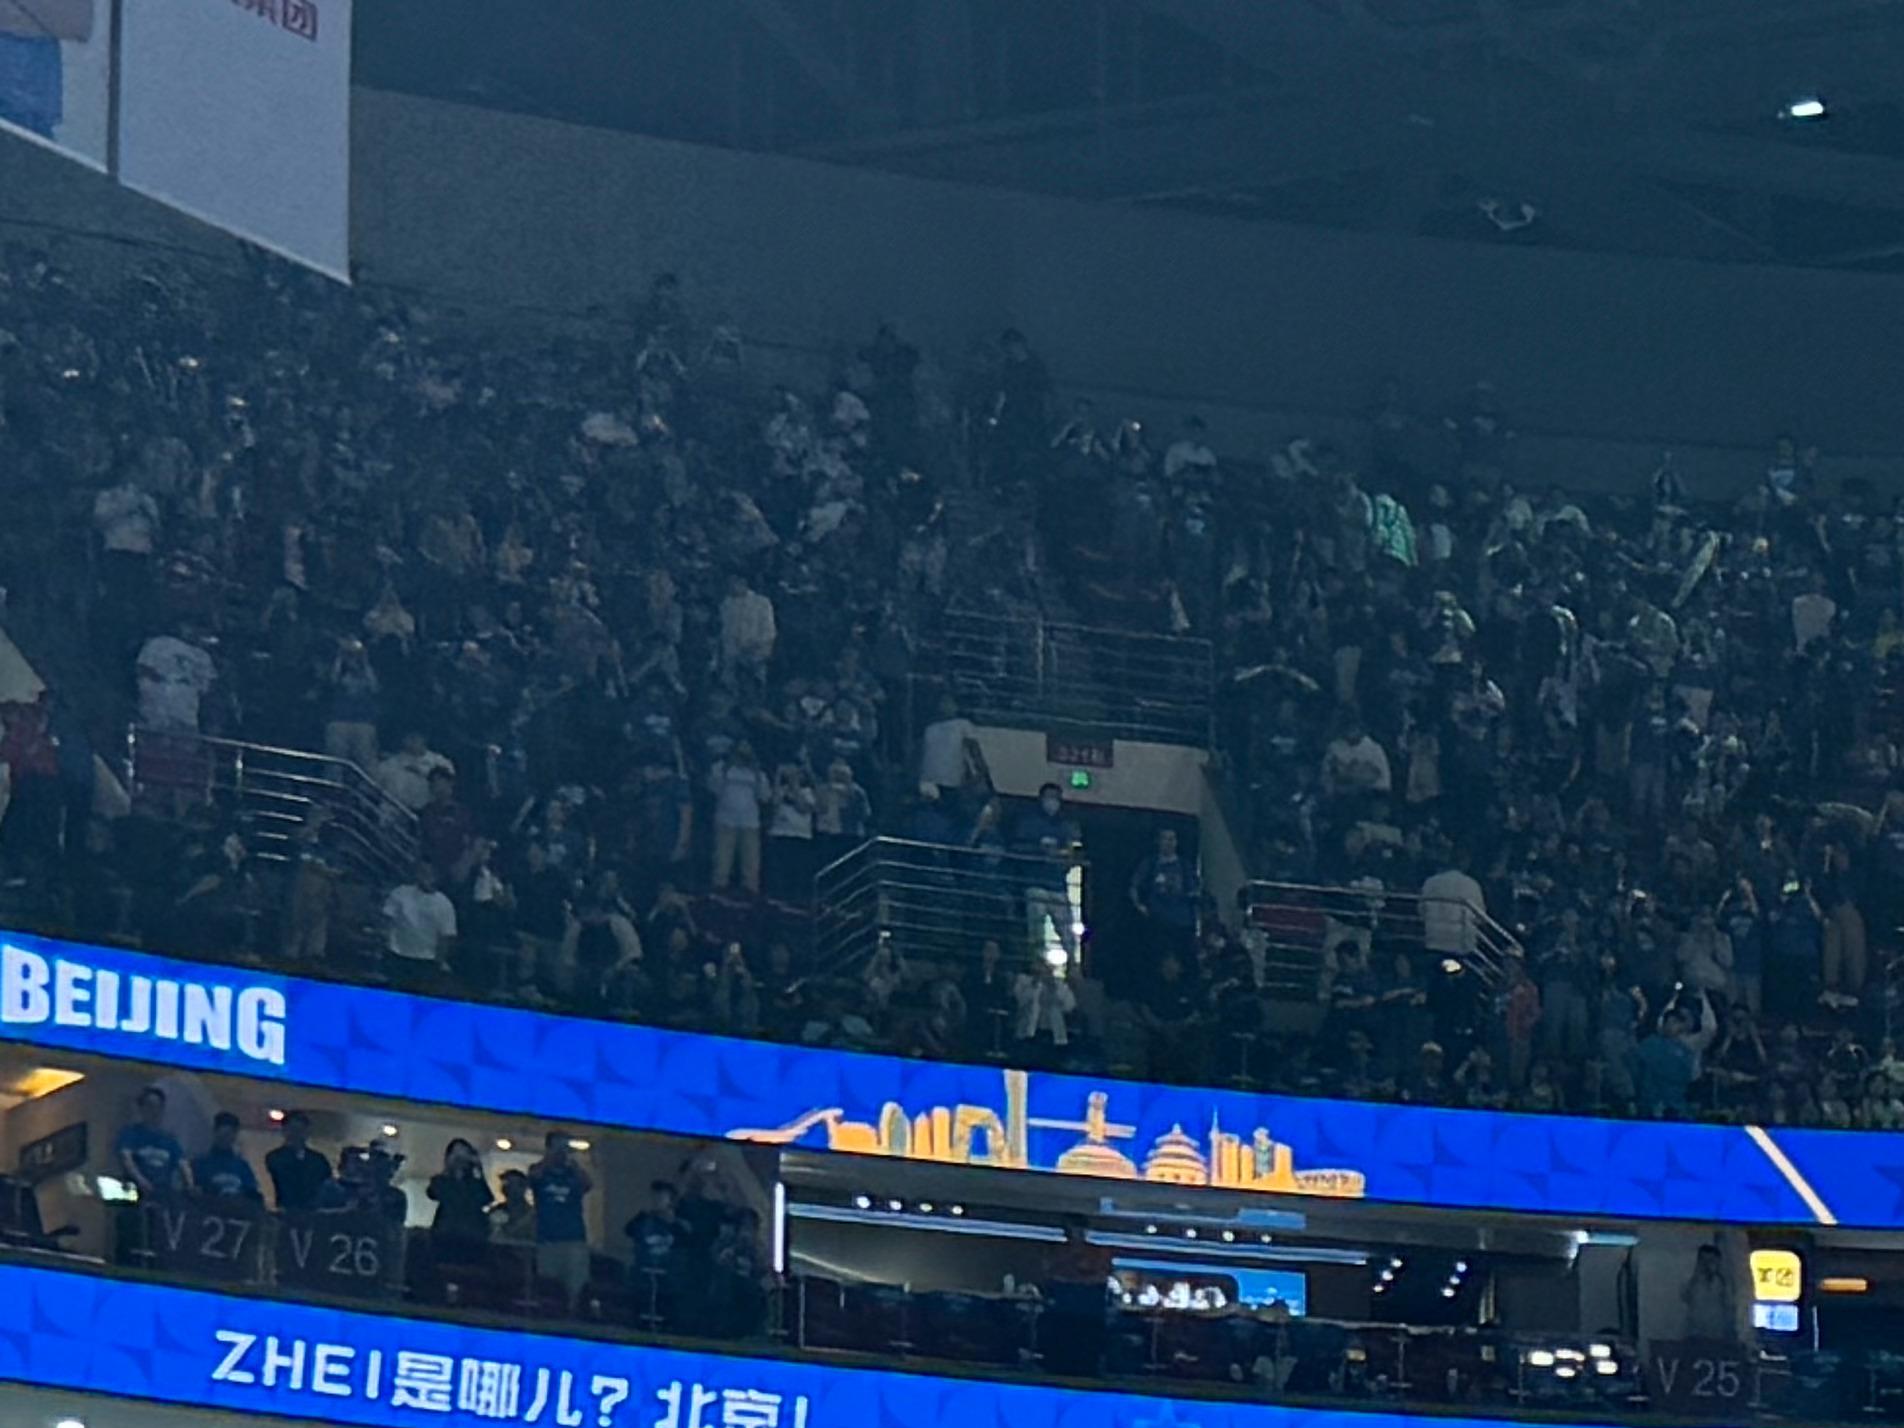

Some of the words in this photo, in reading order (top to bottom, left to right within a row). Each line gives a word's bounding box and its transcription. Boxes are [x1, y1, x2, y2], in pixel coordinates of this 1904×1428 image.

[1, 943, 287, 1066] BEIJING
[162, 1209, 184, 1252] V
[199, 1216, 251, 1261] 27
[290, 1227, 312, 1268] V
[329, 1234, 380, 1278] 26
[1658, 1358, 1682, 1395] V
[1692, 1360, 1741, 1397] 25
